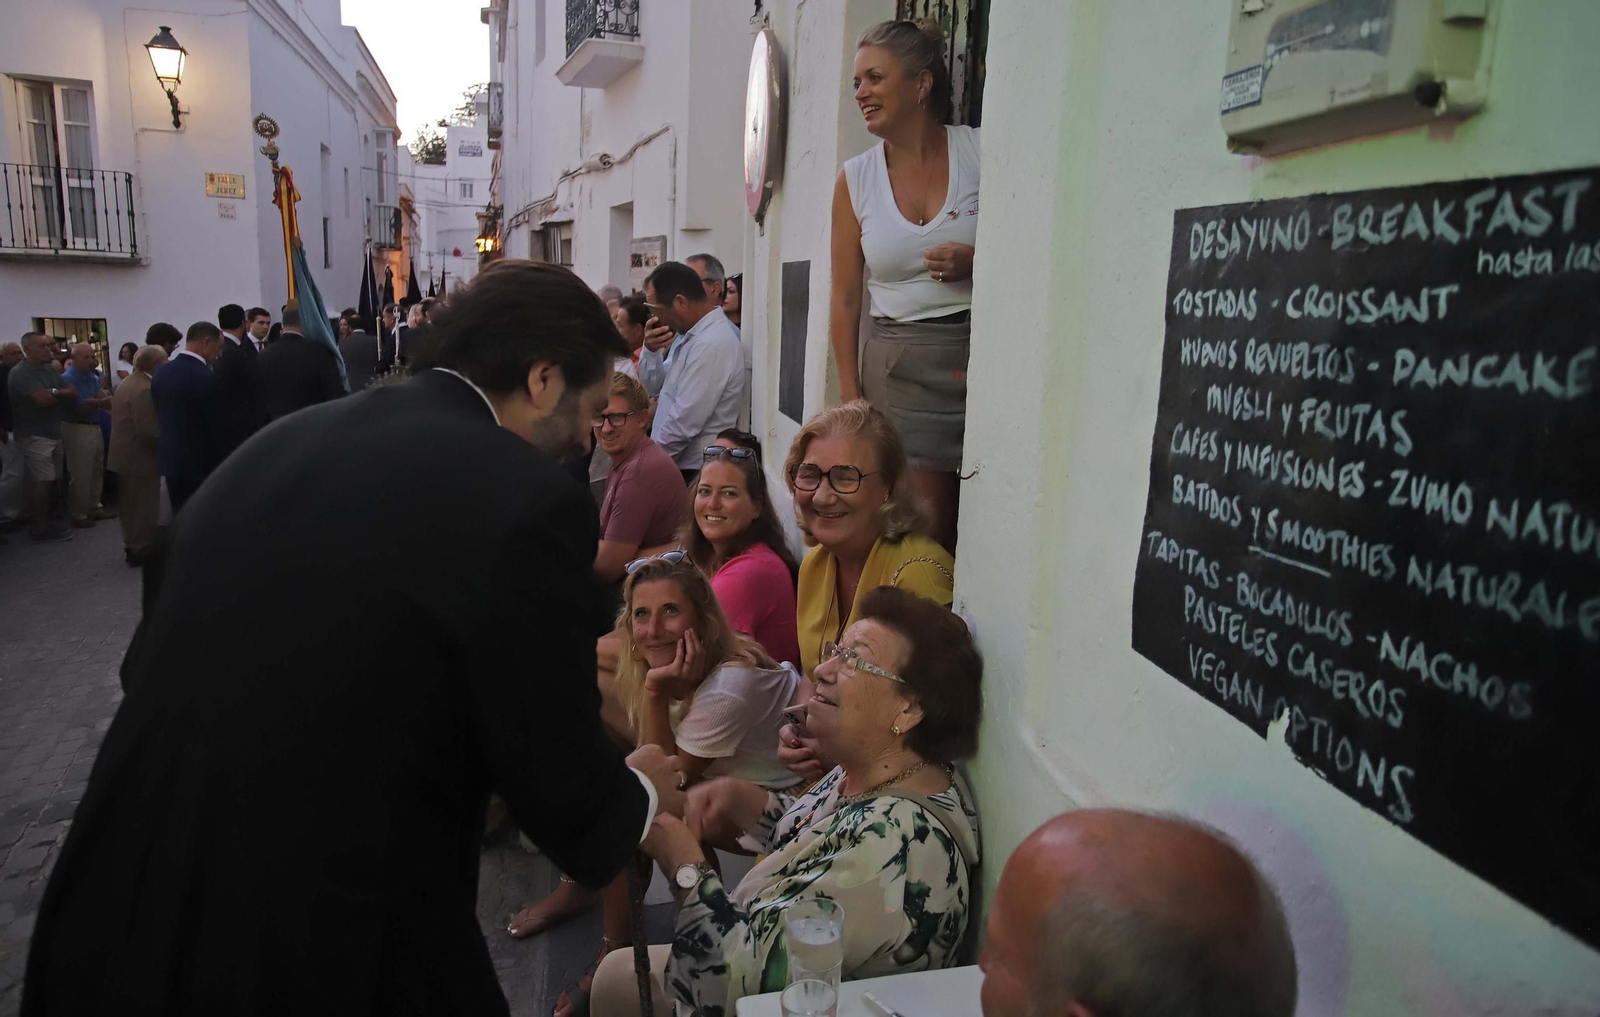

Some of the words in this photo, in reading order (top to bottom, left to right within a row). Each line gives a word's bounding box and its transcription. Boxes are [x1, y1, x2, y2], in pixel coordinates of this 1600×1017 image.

[216, 187, 236, 195] JEREZ
[1190, 212, 1309, 261] DESAYUNO
[1331, 179, 1591, 251] BREAKFAST
[1476, 244, 1554, 278] hasta
[1173, 288, 1257, 320] TOSTADAS
[1286, 284, 1460, 325] CROISSANT
[1245, 338, 1356, 384] REVUELTOS
[1393, 346, 1598, 399] PANCAKE
[1207, 383, 1273, 421] MUESLI
[1299, 397, 1413, 457] FRUTAS
[1170, 422, 1219, 461] CAFES
[1237, 441, 1365, 497] INFUSIONES
[1389, 470, 1473, 525] ZUMO
[1172, 474, 1242, 527] BATIDOS
[1265, 507, 1396, 579] SMOOTHIES
[1148, 531, 1220, 589] TAPITAS
[1236, 572, 1354, 646] BOCADILLOS
[1379, 631, 1533, 719] NACHOS
[1184, 584, 1279, 666] PASTELES
[1288, 643, 1407, 727] CASEROS
[1189, 644, 1264, 716] VEGAN
